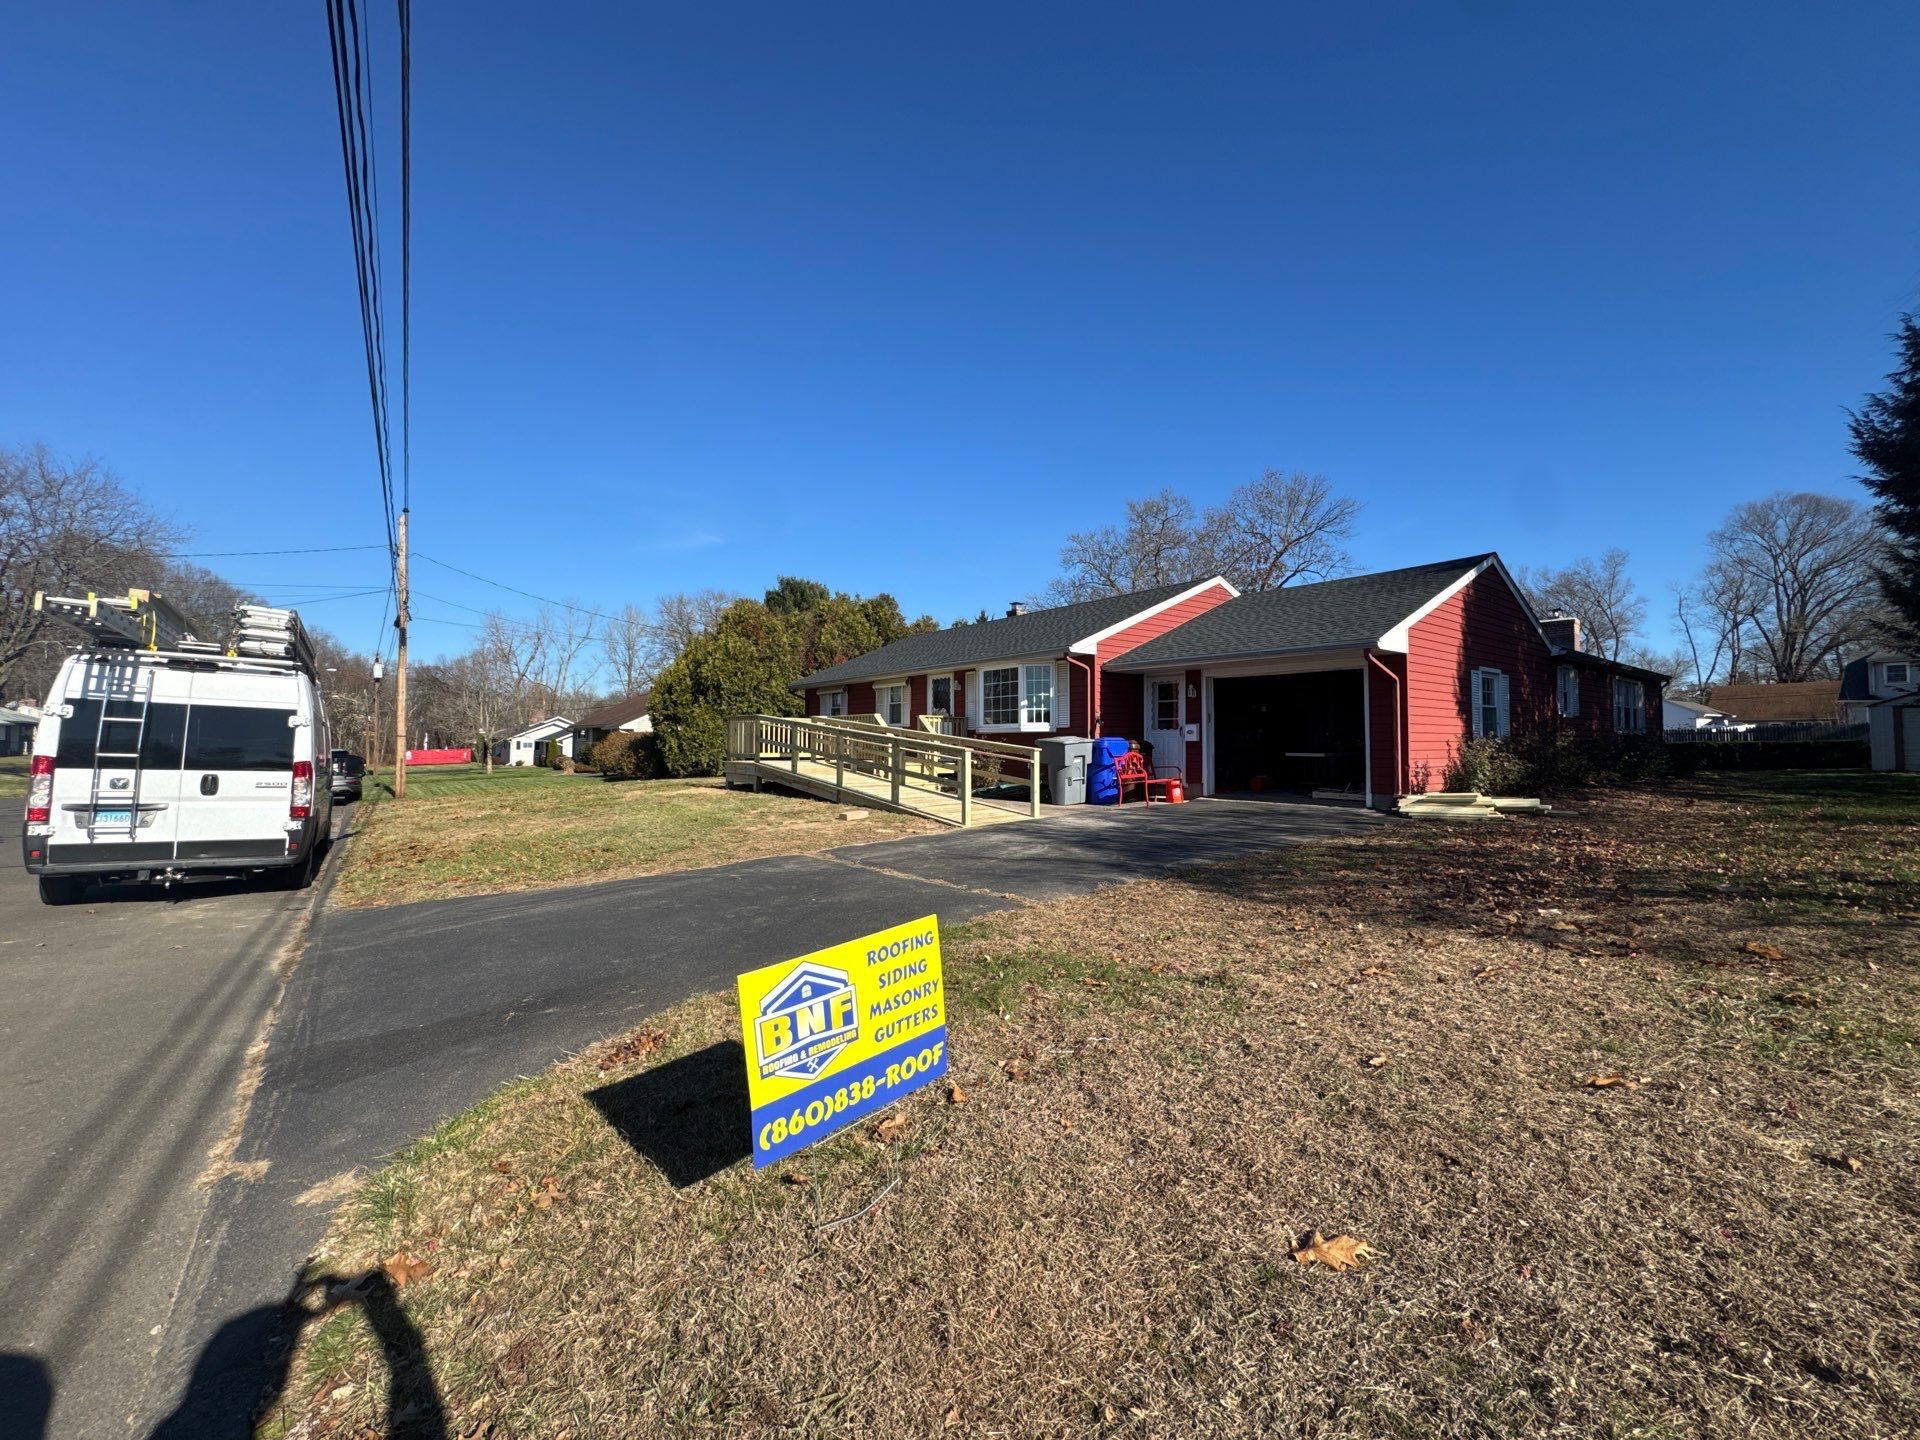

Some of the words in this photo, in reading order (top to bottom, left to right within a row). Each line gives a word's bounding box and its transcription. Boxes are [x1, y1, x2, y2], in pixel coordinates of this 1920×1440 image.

[866, 930, 935, 967] ROOFING
[878, 958, 928, 990] SIDING
[869, 978, 940, 1020] MASONRY
[760, 990, 854, 1059] BNF
[874, 1003, 939, 1043] GUTTERS
[762, 1053, 799, 1076] ROOFING
[800, 1050, 807, 1060] &
[808, 1029, 858, 1056] REMODELING
[759, 1041, 945, 1151] (860)838-ROOF
